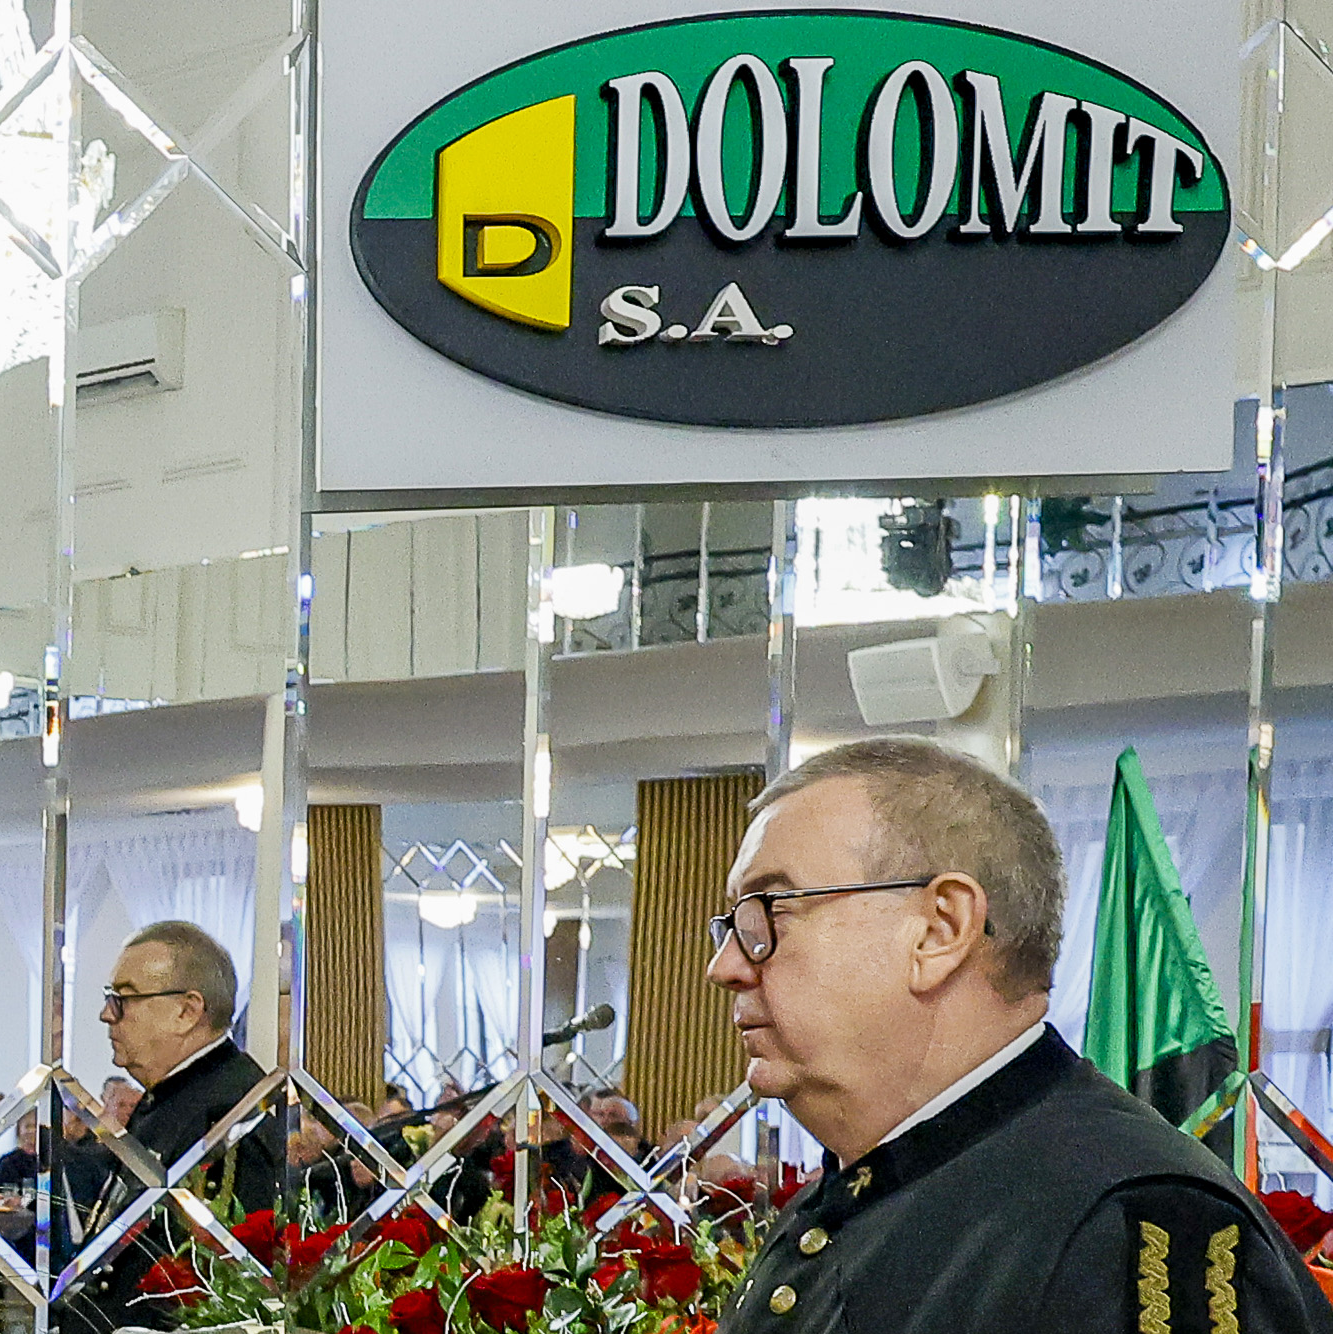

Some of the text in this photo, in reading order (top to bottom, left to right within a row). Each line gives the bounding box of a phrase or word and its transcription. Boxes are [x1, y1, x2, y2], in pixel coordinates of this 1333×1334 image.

[602, 53, 1204, 241] DOLOMIT
[463, 213, 562, 278] D
[599, 281, 795, 346] S.A.
